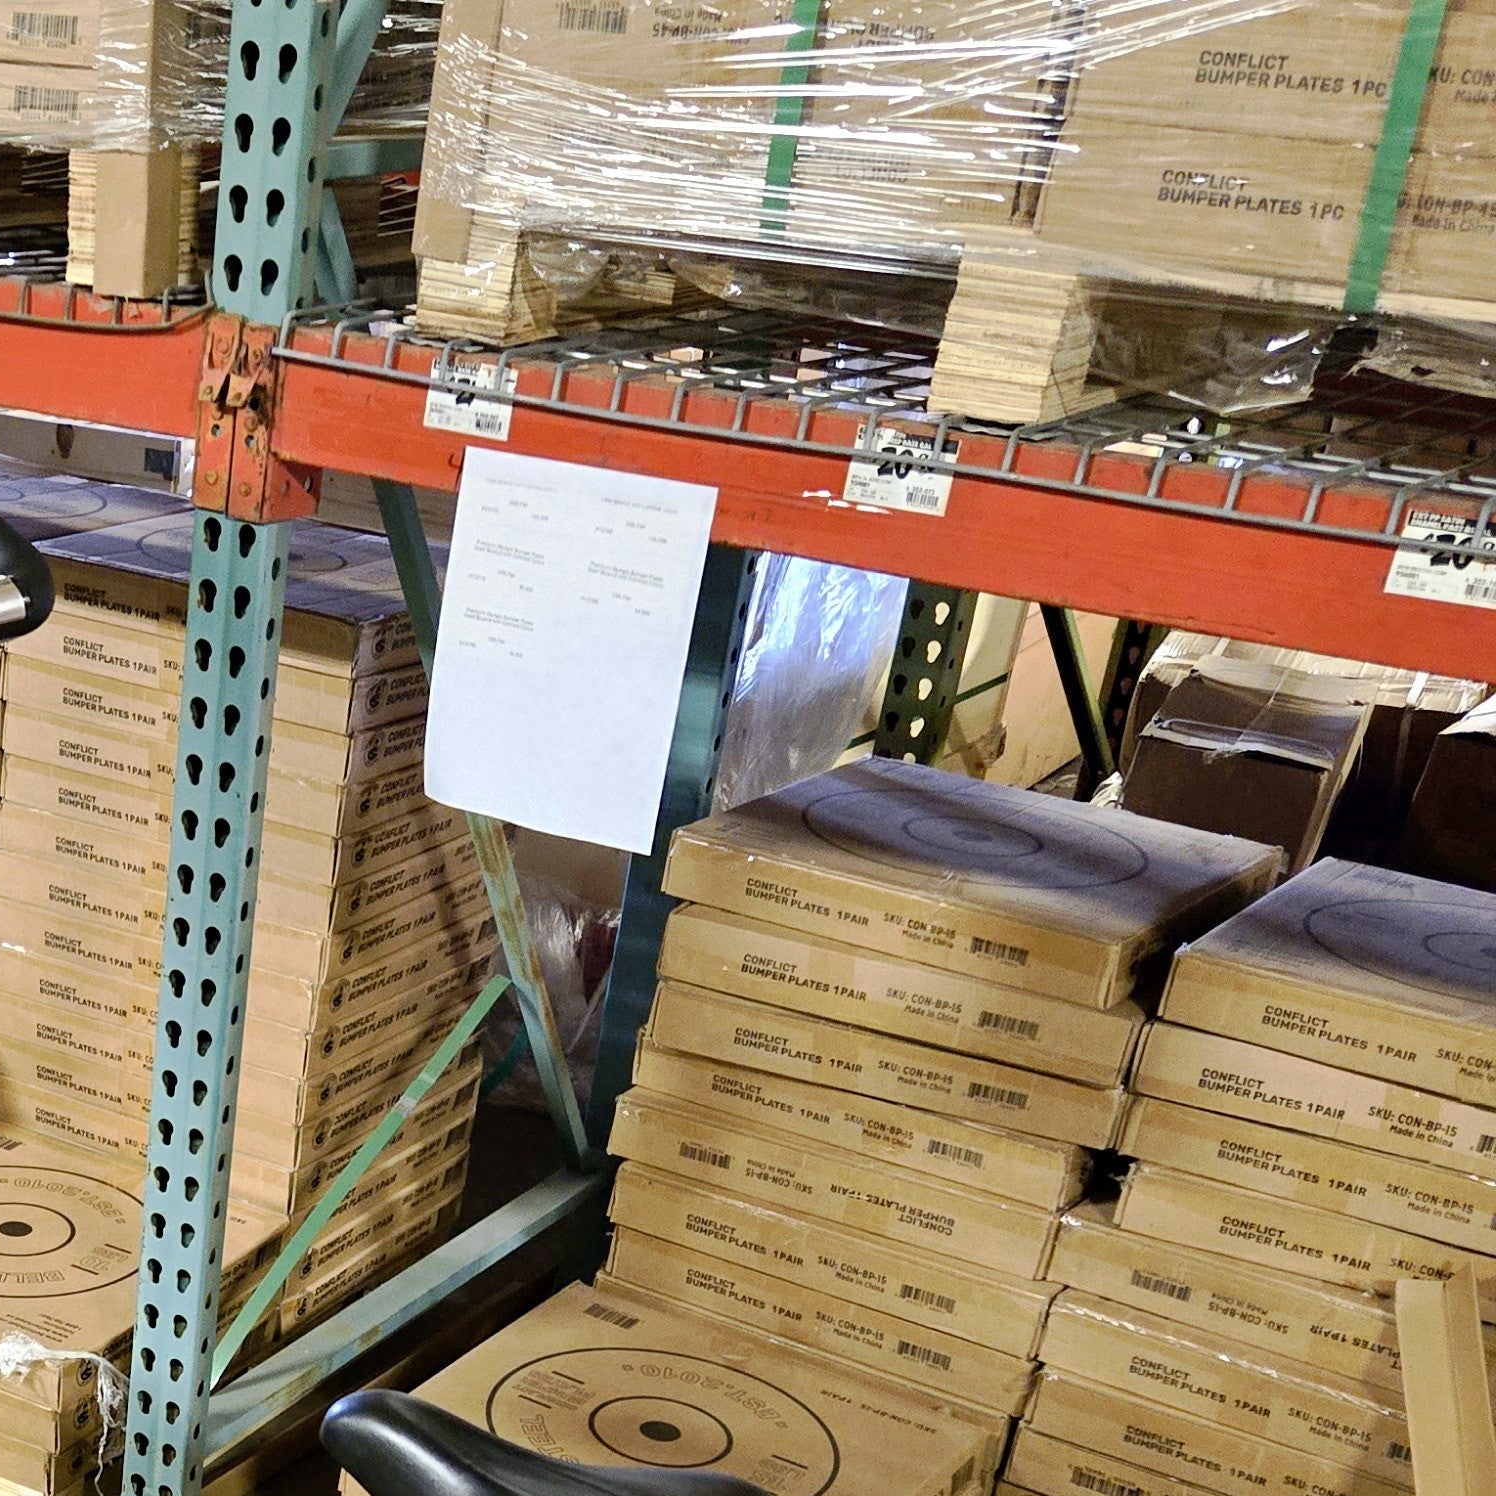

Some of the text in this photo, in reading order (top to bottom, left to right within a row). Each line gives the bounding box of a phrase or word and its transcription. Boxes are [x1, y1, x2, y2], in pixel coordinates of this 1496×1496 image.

[1198, 50, 1287, 71] CONFLICT
[1194, 67, 1270, 88] BUMPER
[1273, 73, 1345, 93] PLATES
[1161, 169, 1247, 192] CONFLICT
[1157, 186, 1232, 208] BUMPER
[1233, 194, 1303, 216] PLATES
[63, 635, 103, 653] CONFLICT
[63, 644, 96, 661] BUMPER
[98, 653, 130, 669] PLATES
[59, 739, 98, 756] CONFLICT
[59, 748, 92, 763] BUMPER
[93, 756, 124, 771] PLATES
[44, 929, 81, 948] CONFLICT
[44, 939, 76, 955] BUMPER
[77, 948, 106, 963] PLATES
[743, 953, 796, 974] CONFLICT
[352, 965, 387, 989] CONFLICT
[740, 963, 786, 982] BUMPER
[787, 974, 829, 992] PLATES
[887, 987, 962, 1014] SKU: CON-BP-15
[1265, 1004, 1328, 1029] CONFLICT
[735, 1027, 789, 1046] CONFLICT
[1261, 1014, 1316, 1037] BUMPER
[1318, 1028, 1368, 1050] PLATES
[733, 1035, 778, 1055] BUMPER
[780, 1046, 822, 1064] PLATES
[878, 1059, 953, 1085] SKU: CON-BP-15
[1201, 1067, 1263, 1090] CONFLICT
[1197, 1077, 1251, 1099] BUMPER
[1253, 1090, 1302, 1110] PLATES
[35, 1105, 71, 1125] CONFLICT
[1368, 1105, 1456, 1137] SKU: CON-BP-15
[35, 1114, 65, 1131] BUMPER
[67, 1124, 95, 1141] PLATES
[1388, 1124, 1453, 1148] Made in China
[1220, 1139, 1281, 1163] CONFLICT
[1217, 1148, 1269, 1171] BUMPER
[1271, 1162, 1319, 1184] PLATES
[865, 1193, 954, 1227] BUMPER PLATES
[686, 1212, 736, 1236] CONFLICT
[898, 1213, 952, 1235] CONFLICT
[685, 1222, 727, 1243] BUMPER
[728, 1235, 766, 1255] PLATES
[817, 1254, 886, 1285] SKU: CON-BP-15
